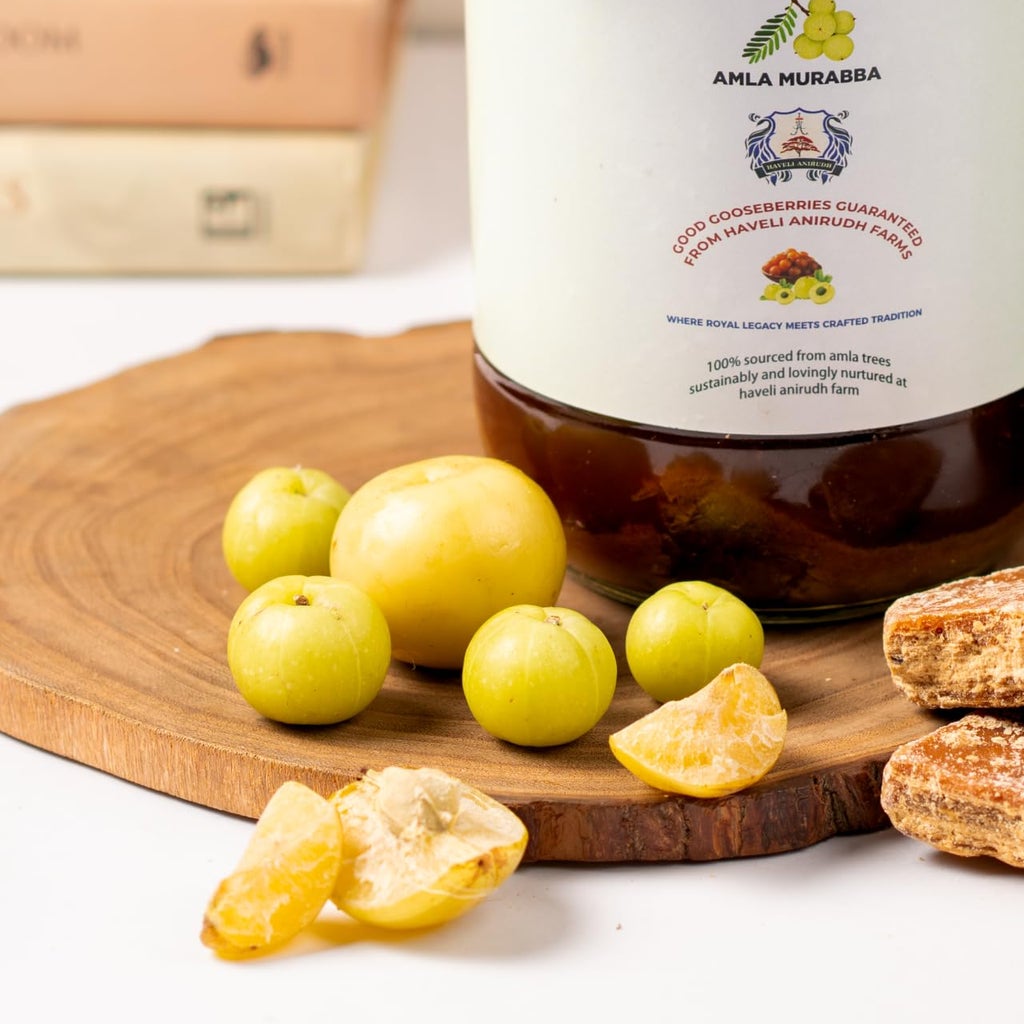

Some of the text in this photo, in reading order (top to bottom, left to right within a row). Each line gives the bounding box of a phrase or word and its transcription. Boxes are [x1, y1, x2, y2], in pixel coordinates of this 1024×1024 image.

[712, 66, 882, 86] AMLA MURABBA
[766, 161, 795, 170] HAVELI
[673, 200, 923, 254] GOOD GOOSEBERRIES GUARANTEED
[684, 216, 913, 267] FROM HAVELI ANIRUDH FARMS
[666, 308, 923, 330] WHERE ROYAL LEGACY MEETS CRAFTED TRADITION
[707, 350, 891, 372] 100% sourced from amla trees
[689, 366, 907, 394] sustainably and lovingly nurtured at
[739, 382, 859, 399] haveli anirudh farm
